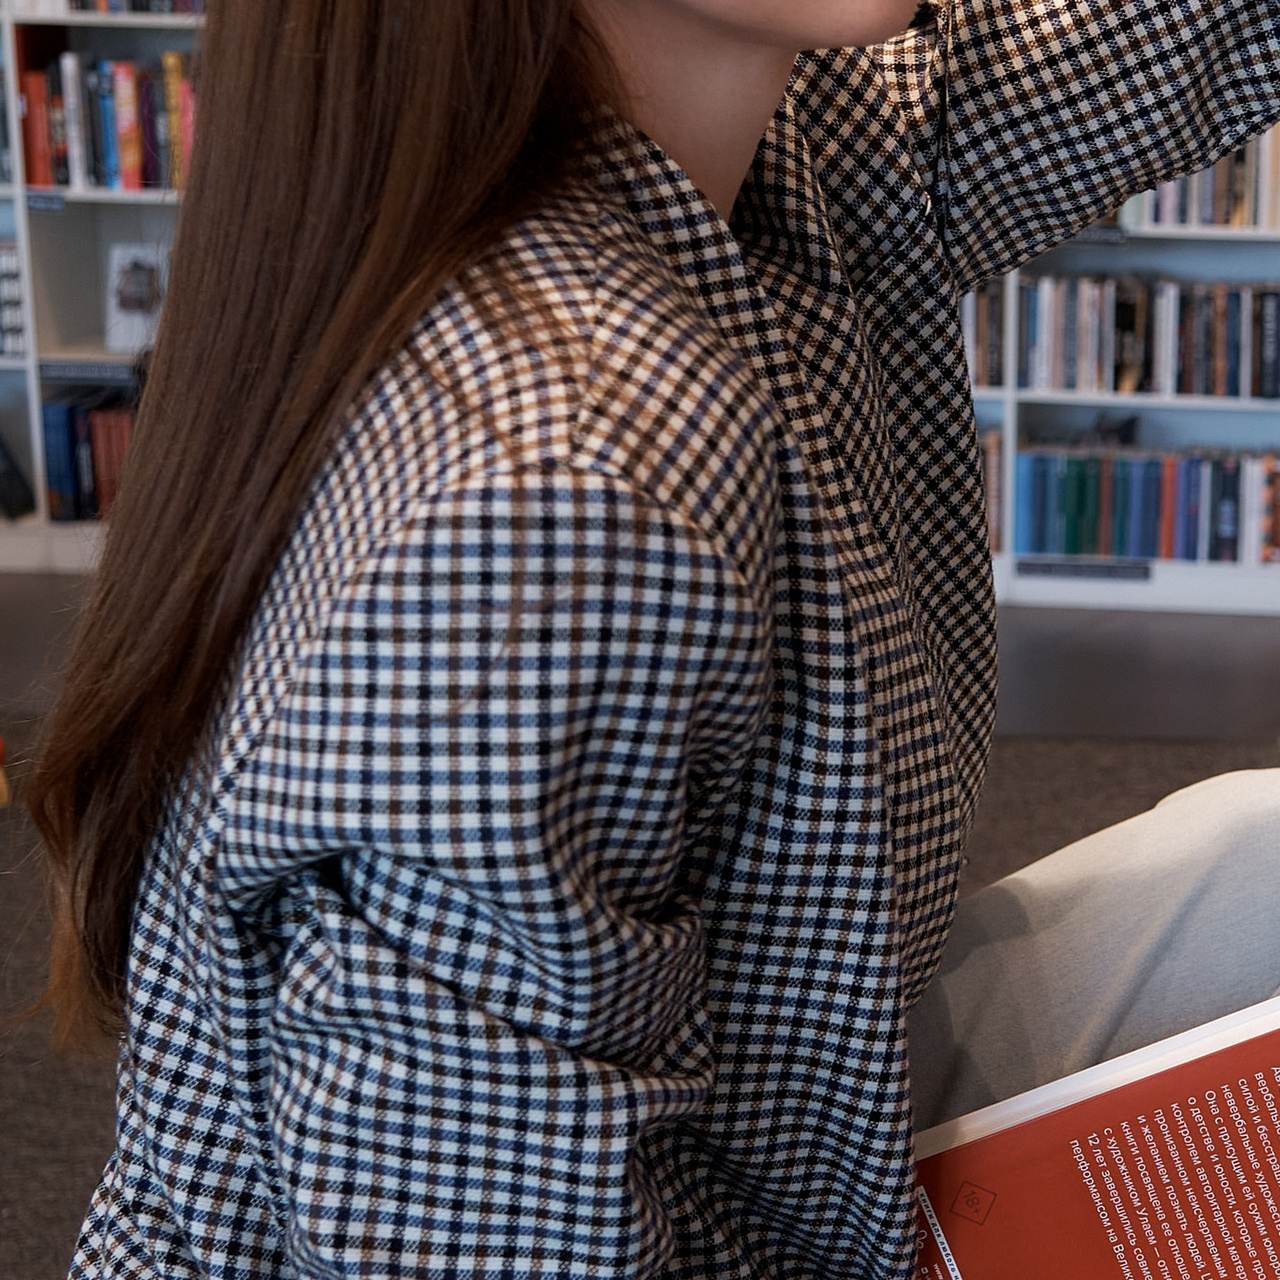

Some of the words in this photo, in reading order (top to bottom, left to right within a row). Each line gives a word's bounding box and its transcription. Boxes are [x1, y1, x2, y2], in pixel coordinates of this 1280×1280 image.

[1137, 1115, 1147, 1124] и
[1187, 1097, 1197, 1105] о
[1205, 1090, 1220, 1115] Она
[1214, 1117, 1224, 1125] с
[1238, 1078, 1260, 1114] силой
[1252, 1115, 1262, 1124] и
[1087, 1132, 1100, 1147] 12
[1104, 1127, 1113, 1136] с
[1189, 1107, 1215, 1152] детстве
[1220, 1084, 1261, 1170] невербальные
[1092, 1148, 1107, 1167] лет
[1106, 1136, 1142, 1207] художником
[1140, 1124, 1171, 1184] желанием
[1170, 1102, 1202, 1166] контролем
[1196, 1166, 1235, 1245] авторитарной
[1209, 1153, 1219, 1162] и
[1218, 1126, 1248, 1185] присущим
[1069, 1139, 1112, 1227] перформансом
[1106, 1228, 1118, 1243] на
[1120, 1121, 1140, 1155] книги
[1134, 1156, 1166, 1221] посвящена
[1161, 1222, 1173, 1237] ее
[1153, 1109, 1191, 1186] пронизанном
[1185, 1187, 1228, 1279] неисчерпаемым
[1213, 1163, 1237, 1209] юности,
[1242, 1186, 1256, 1201] ей
[961, 1188, 984, 1217] 18+
[1101, 1169, 1137, 1246] завершились
[1165, 1185, 1188, 1231] познать
[1248, 1202, 1268, 1236] сухим
[1135, 1207, 1157, 1245] Улаем
[1232, 1209, 1257, 1258] которые
[938, 1239, 957, 1273] любого
[1183, 1232, 1207, 1272] людей.
